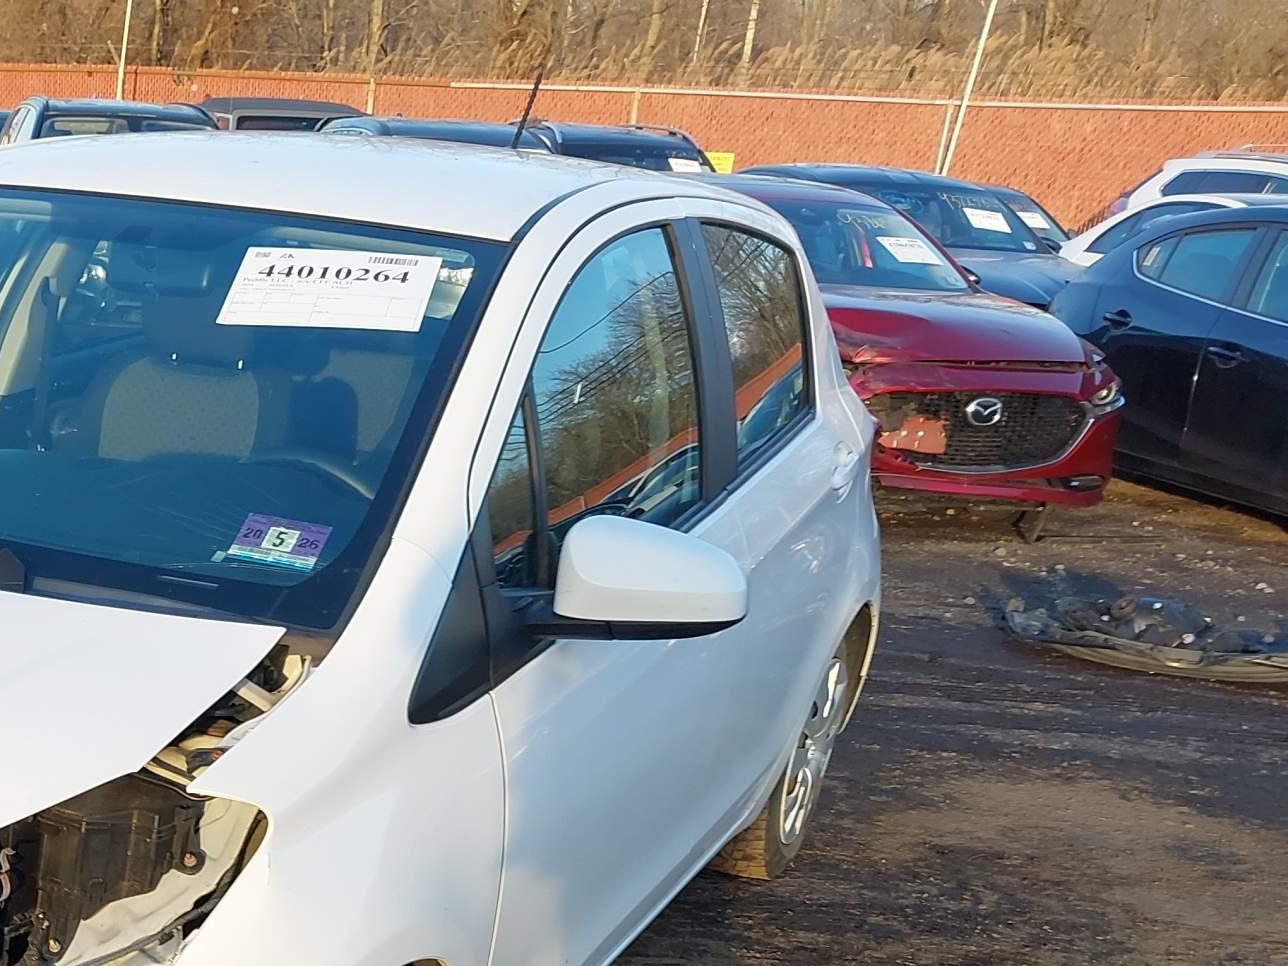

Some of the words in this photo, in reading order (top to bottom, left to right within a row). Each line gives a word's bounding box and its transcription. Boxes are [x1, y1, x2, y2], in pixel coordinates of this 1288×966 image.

[257, 263, 410, 284] 44010264
[242, 527, 264, 539] 20
[272, 530, 289, 548] 5
[297, 537, 321, 550] 26
